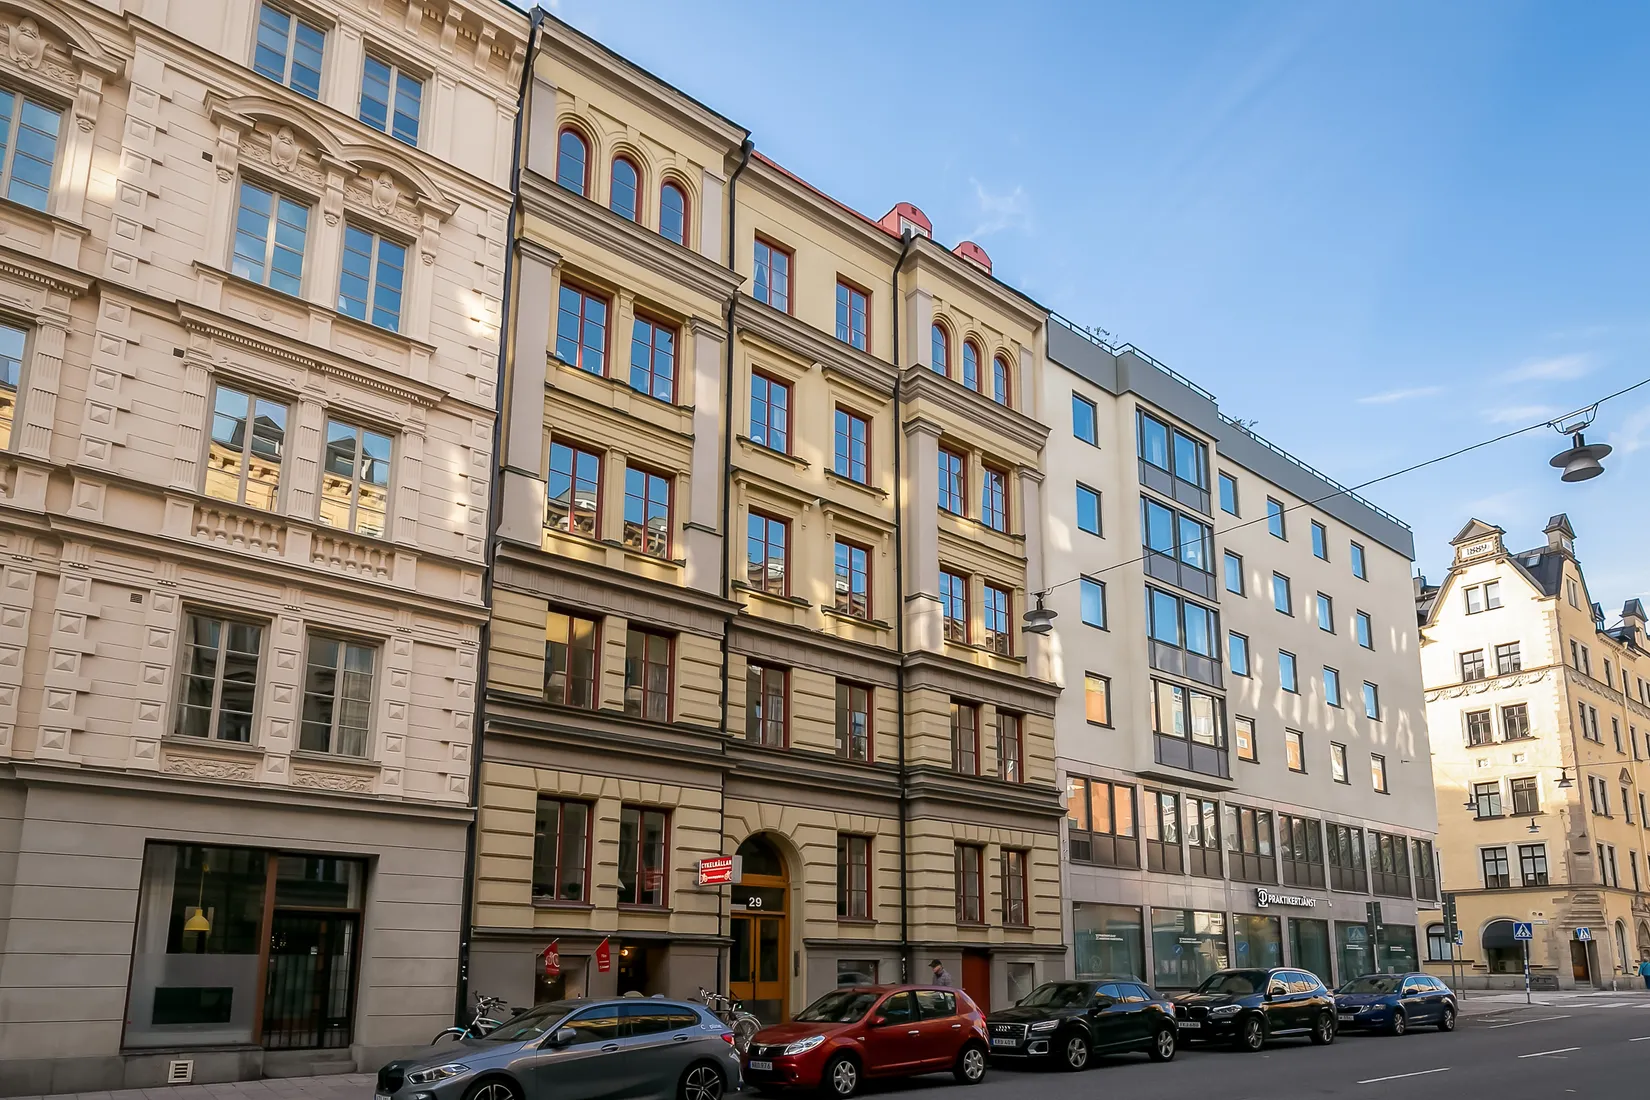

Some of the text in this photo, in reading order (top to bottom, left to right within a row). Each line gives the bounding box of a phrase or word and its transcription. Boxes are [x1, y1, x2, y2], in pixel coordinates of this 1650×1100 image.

[1466, 544, 1487, 555] 1889
[748, 896, 762, 907] 29
[1268, 894, 1316, 907] PRAKTIKERTJÄNST
